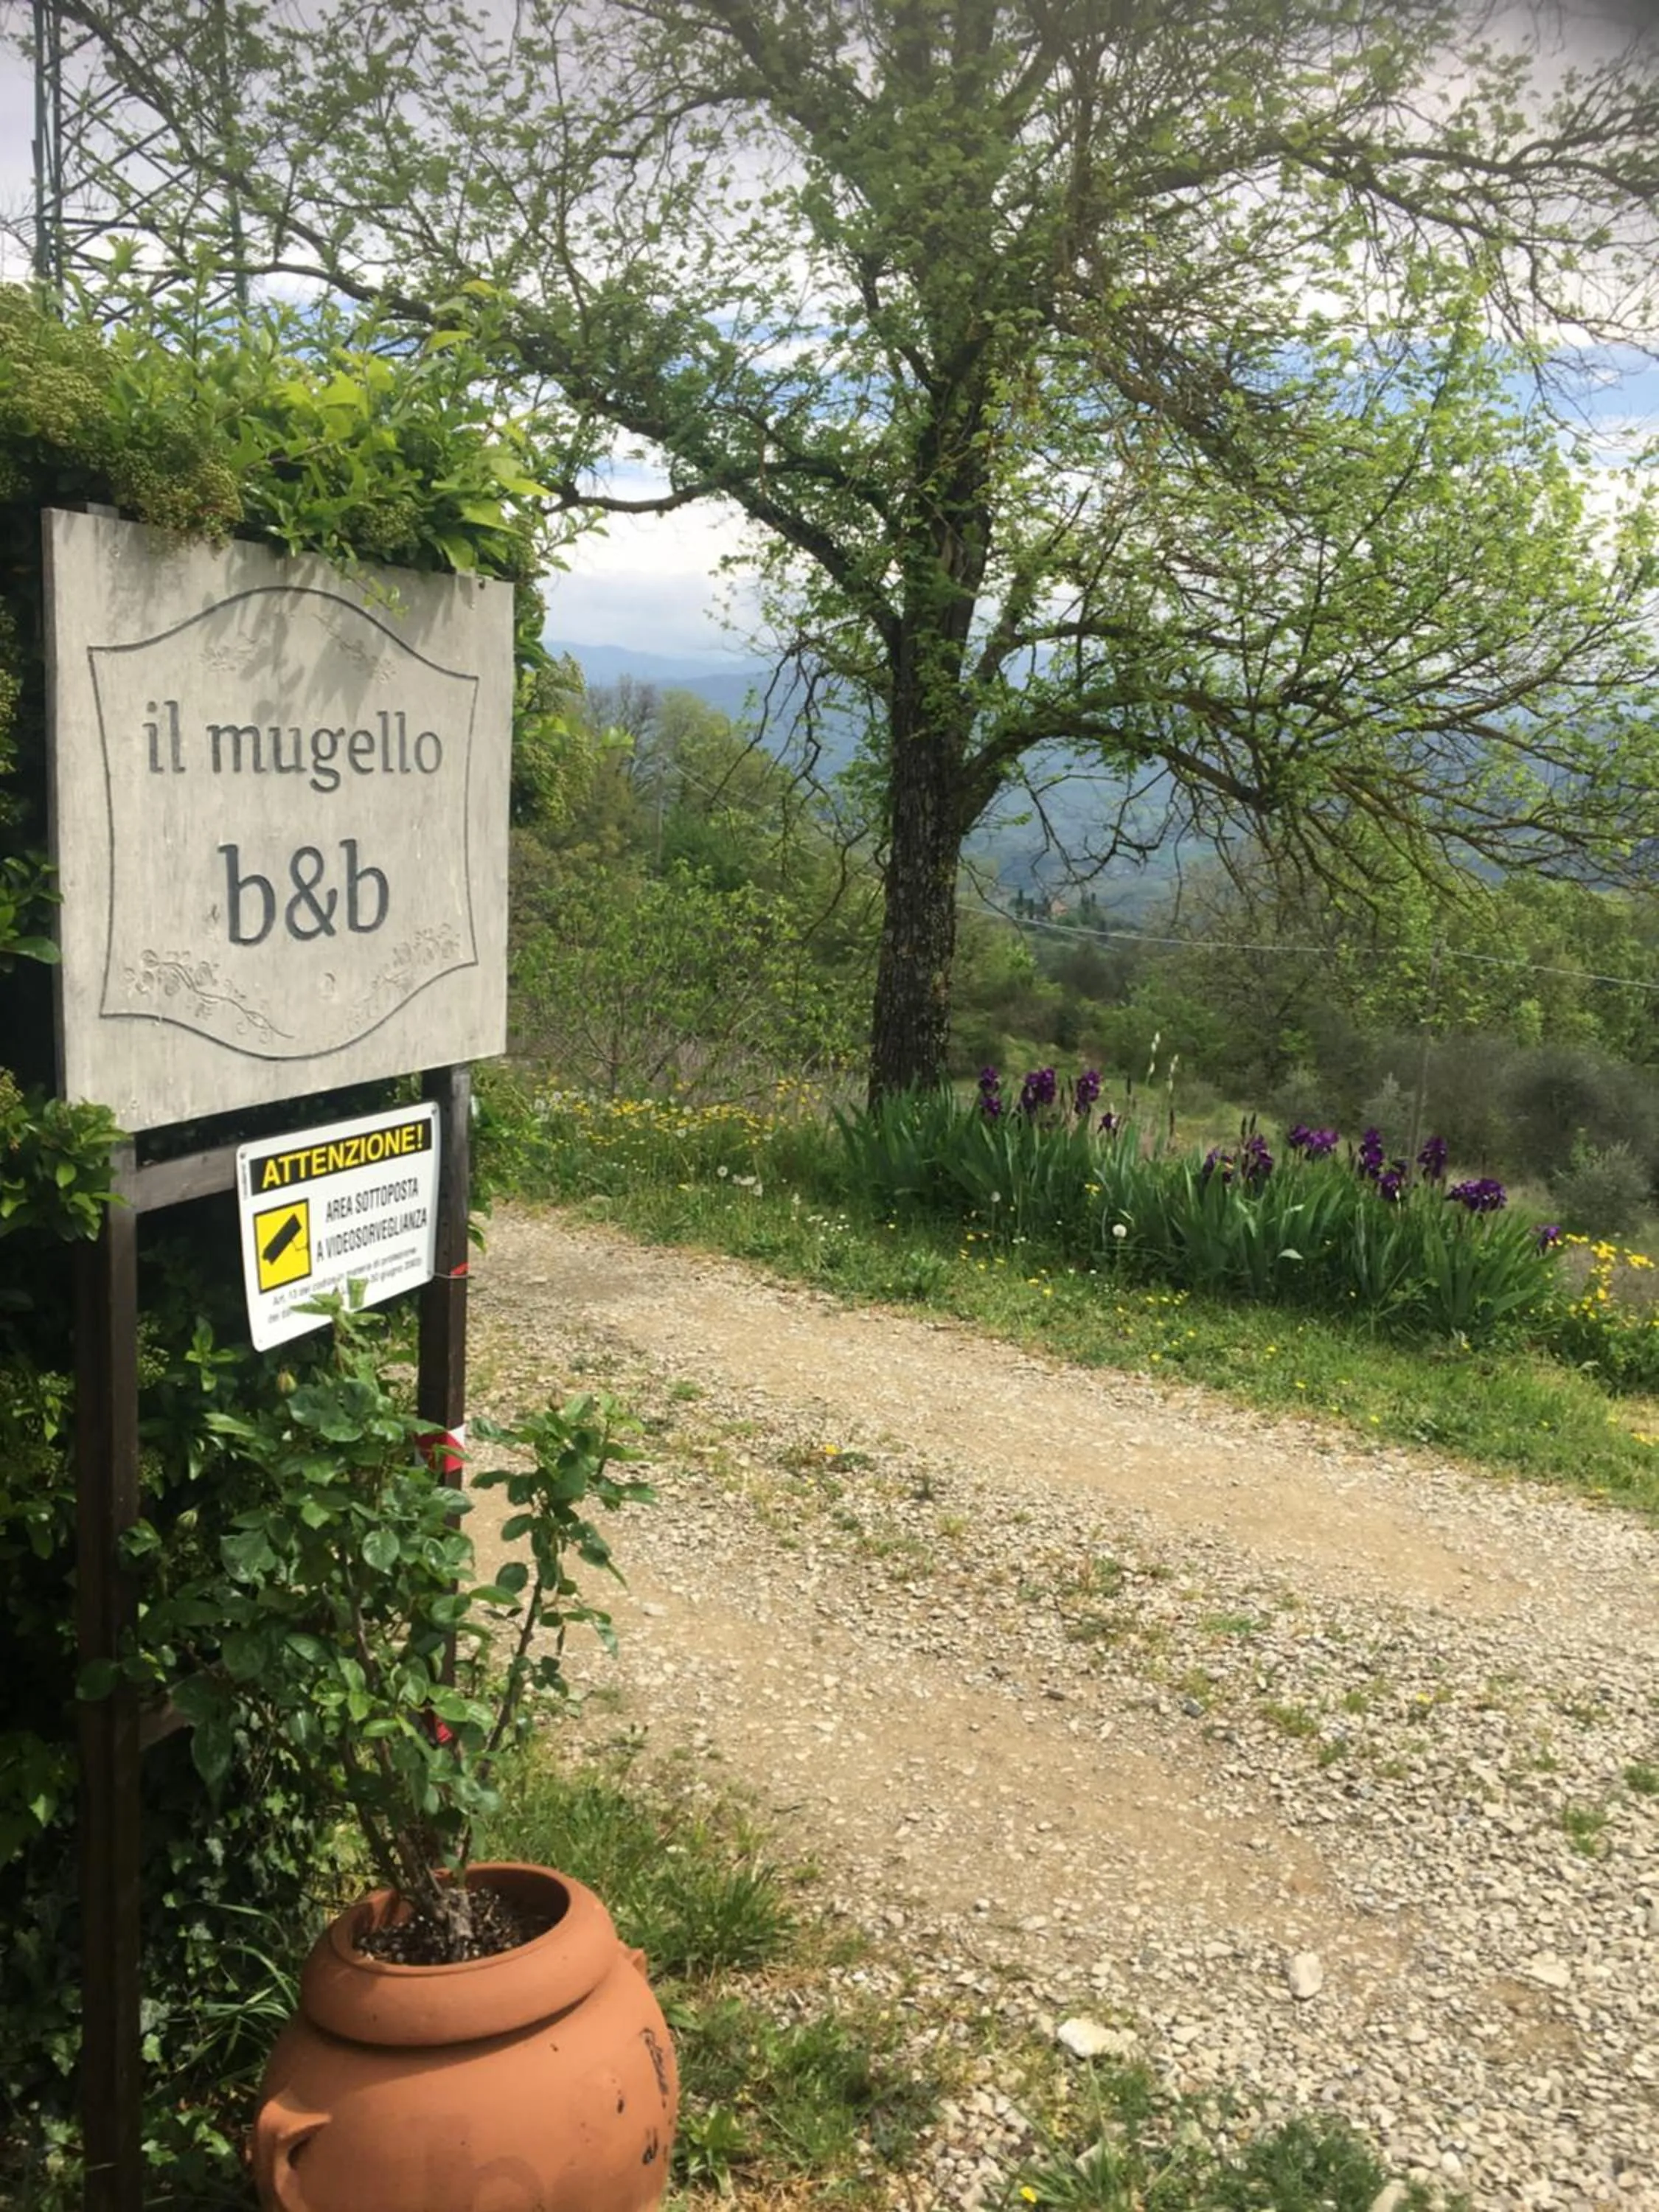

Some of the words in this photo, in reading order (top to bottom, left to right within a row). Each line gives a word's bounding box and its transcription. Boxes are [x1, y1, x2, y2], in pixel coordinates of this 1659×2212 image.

[142, 700, 186, 773] il
[206, 711, 442, 793] mugello
[218, 838, 389, 946] b&b
[262, 1123, 423, 1189] ATTENZIONE!
[325, 1195, 352, 1222] AREA
[355, 1177, 419, 1214] SOTTOPOSTA
[316, 1240, 324, 1262] A
[325, 1207, 428, 1259] VIDEOSORVEGLIANZA
